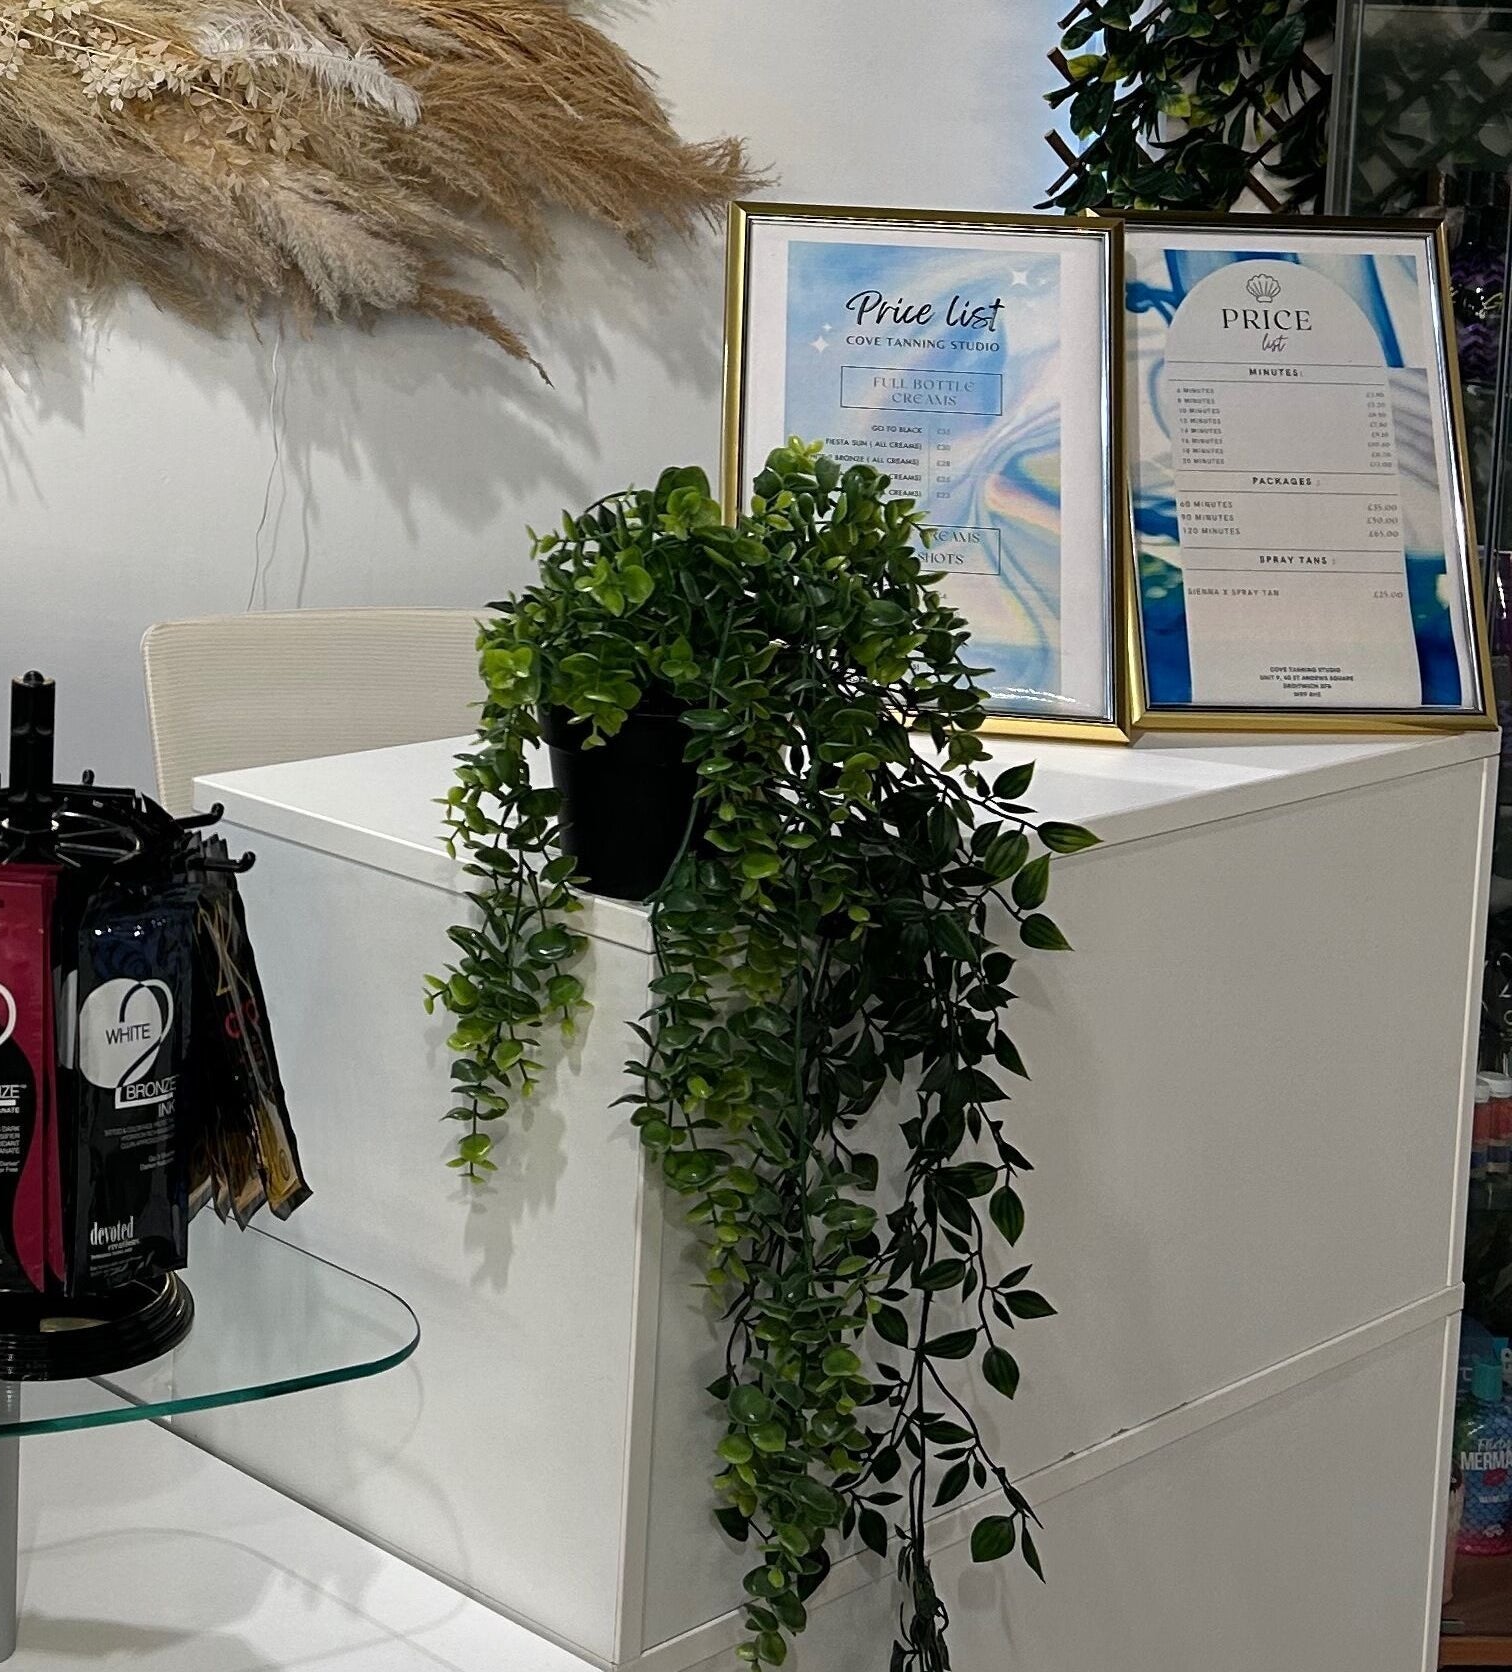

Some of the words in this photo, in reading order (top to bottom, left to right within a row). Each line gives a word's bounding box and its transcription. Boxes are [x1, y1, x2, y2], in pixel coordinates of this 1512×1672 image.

[845, 290, 935, 325] Price
[946, 295, 1005, 332] list
[1221, 308, 1312, 330] PRICE
[846, 335, 880, 346] COVE
[887, 337, 945, 350] TANNING
[951, 340, 1000, 352] STUDIO
[1262, 333, 1288, 352] list
[873, 377, 905, 389] FULL
[913, 379, 975, 392] BOTTLE
[892, 393, 957, 406] CREAMS
[899, 426, 923, 434] BLACK
[825, 438, 849, 446] FIESTA
[1252, 477, 1312, 486] PACKAGES
[932, 531, 980, 543] REAMS
[1259, 555, 1294, 564] SPRAY
[1299, 556, 1327, 565] TANS
[105, 1023, 151, 1044] WHITE
[126, 1077, 176, 1100] BRONZE
[90, 1215, 134, 1246] devoted
